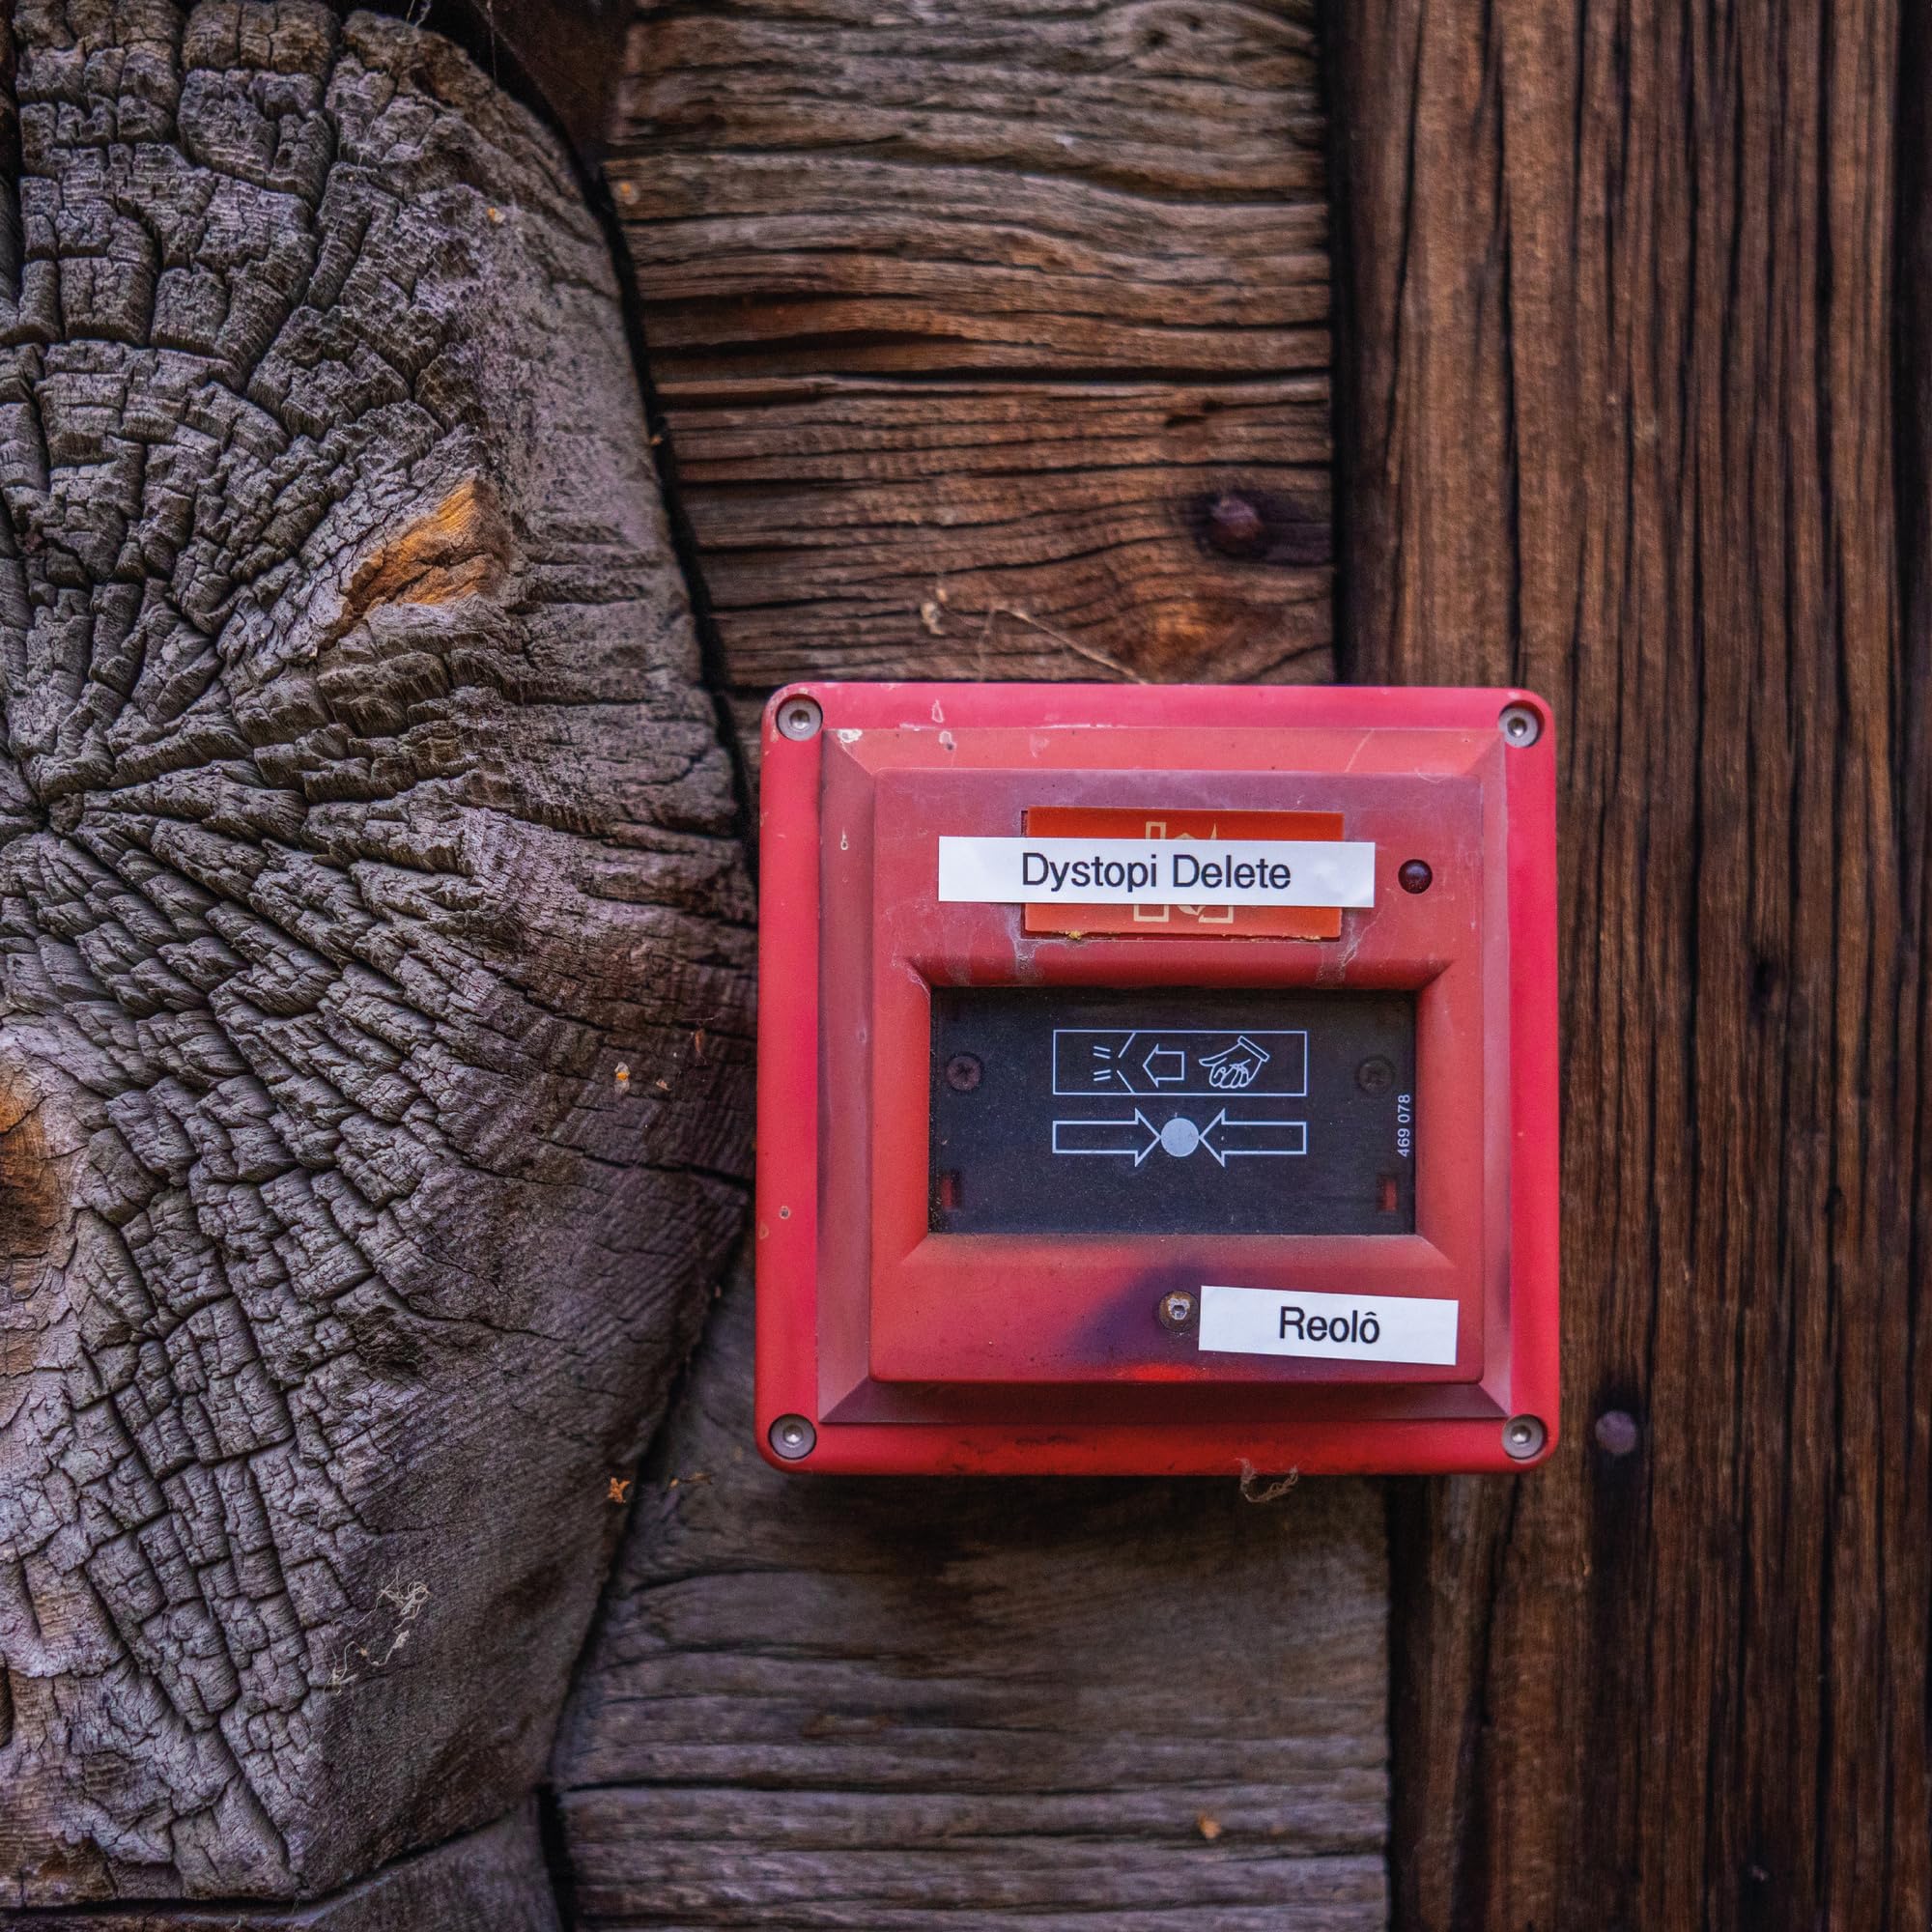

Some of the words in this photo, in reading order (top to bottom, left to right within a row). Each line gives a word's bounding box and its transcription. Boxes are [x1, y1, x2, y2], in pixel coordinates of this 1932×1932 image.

[1021, 851, 1157, 893] Dystopi
[1172, 854, 1292, 890] Delete
[1397, 1094, 1410, 1123] 078
[1397, 1127, 1410, 1158] 469
[1278, 1305, 1380, 1345] Reolô
